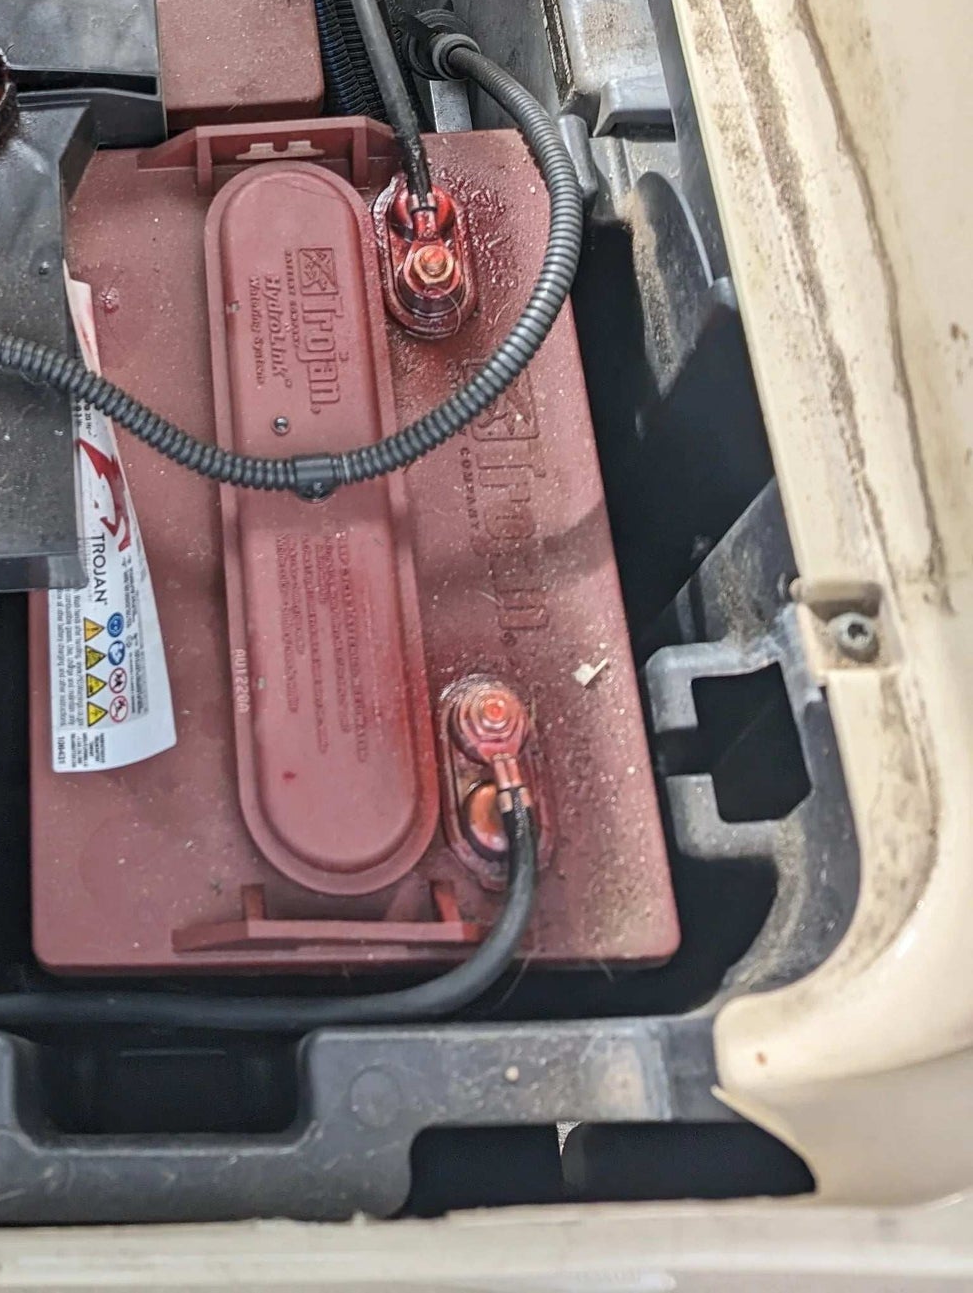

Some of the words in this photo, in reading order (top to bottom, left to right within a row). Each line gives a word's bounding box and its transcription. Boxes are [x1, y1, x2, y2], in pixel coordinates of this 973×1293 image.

[265, 274, 287, 379] HydroLink
[298, 294, 348, 405] Trojan
[91, 531, 108, 604] TROJAN
